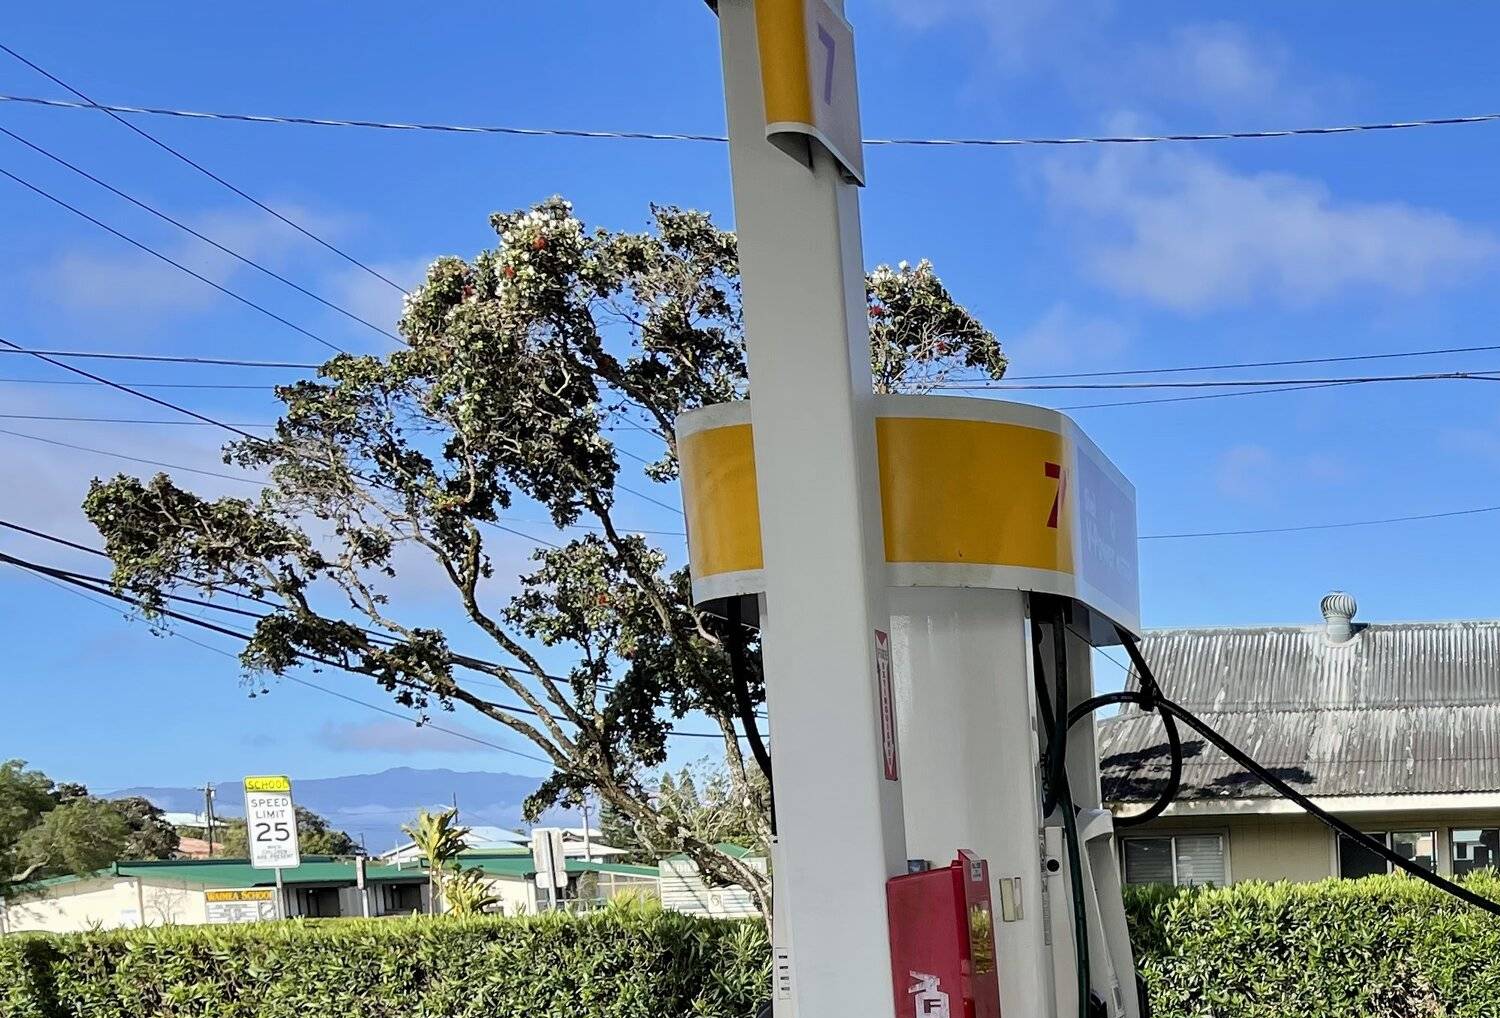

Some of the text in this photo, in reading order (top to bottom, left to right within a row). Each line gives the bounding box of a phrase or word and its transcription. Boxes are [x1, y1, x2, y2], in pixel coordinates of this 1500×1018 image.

[1043, 461, 1067, 528] 7
[247, 779, 289, 791] SCHOOL
[250, 798, 289, 808] SPEED
[255, 809, 286, 819] LIMIT
[255, 822, 290, 842] 25
